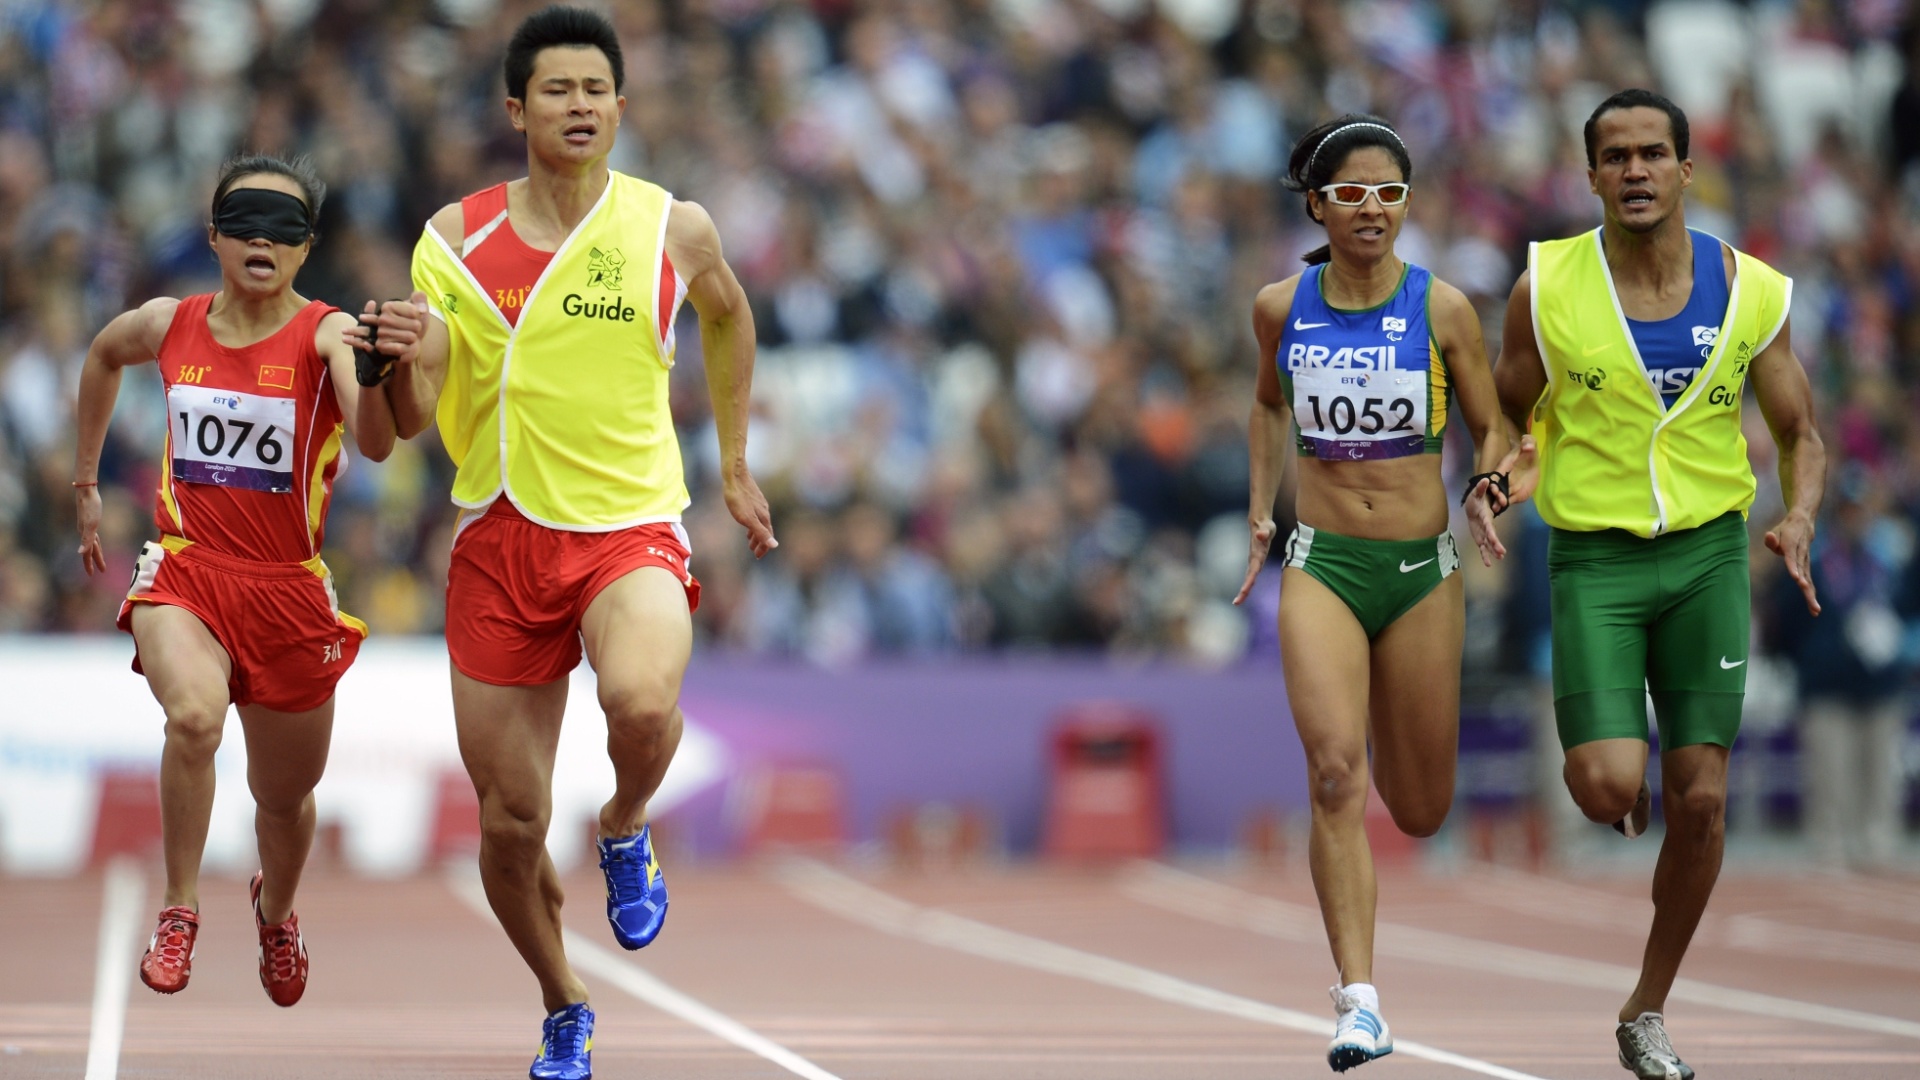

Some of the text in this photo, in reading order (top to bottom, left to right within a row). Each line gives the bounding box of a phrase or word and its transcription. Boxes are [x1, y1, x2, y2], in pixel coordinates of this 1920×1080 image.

[562, 293, 636, 323] Guide
[1287, 343, 1407, 371] BRASIL
[1341, 376, 1356, 385] BT
[1567, 369, 1584, 384] BT
[213, 396, 228, 405] BT
[1307, 395, 1415, 435] 1052
[179, 411, 283, 465] 1076
[1339, 440, 1372, 448] London 2012
[204, 463, 237, 473] London 2012
